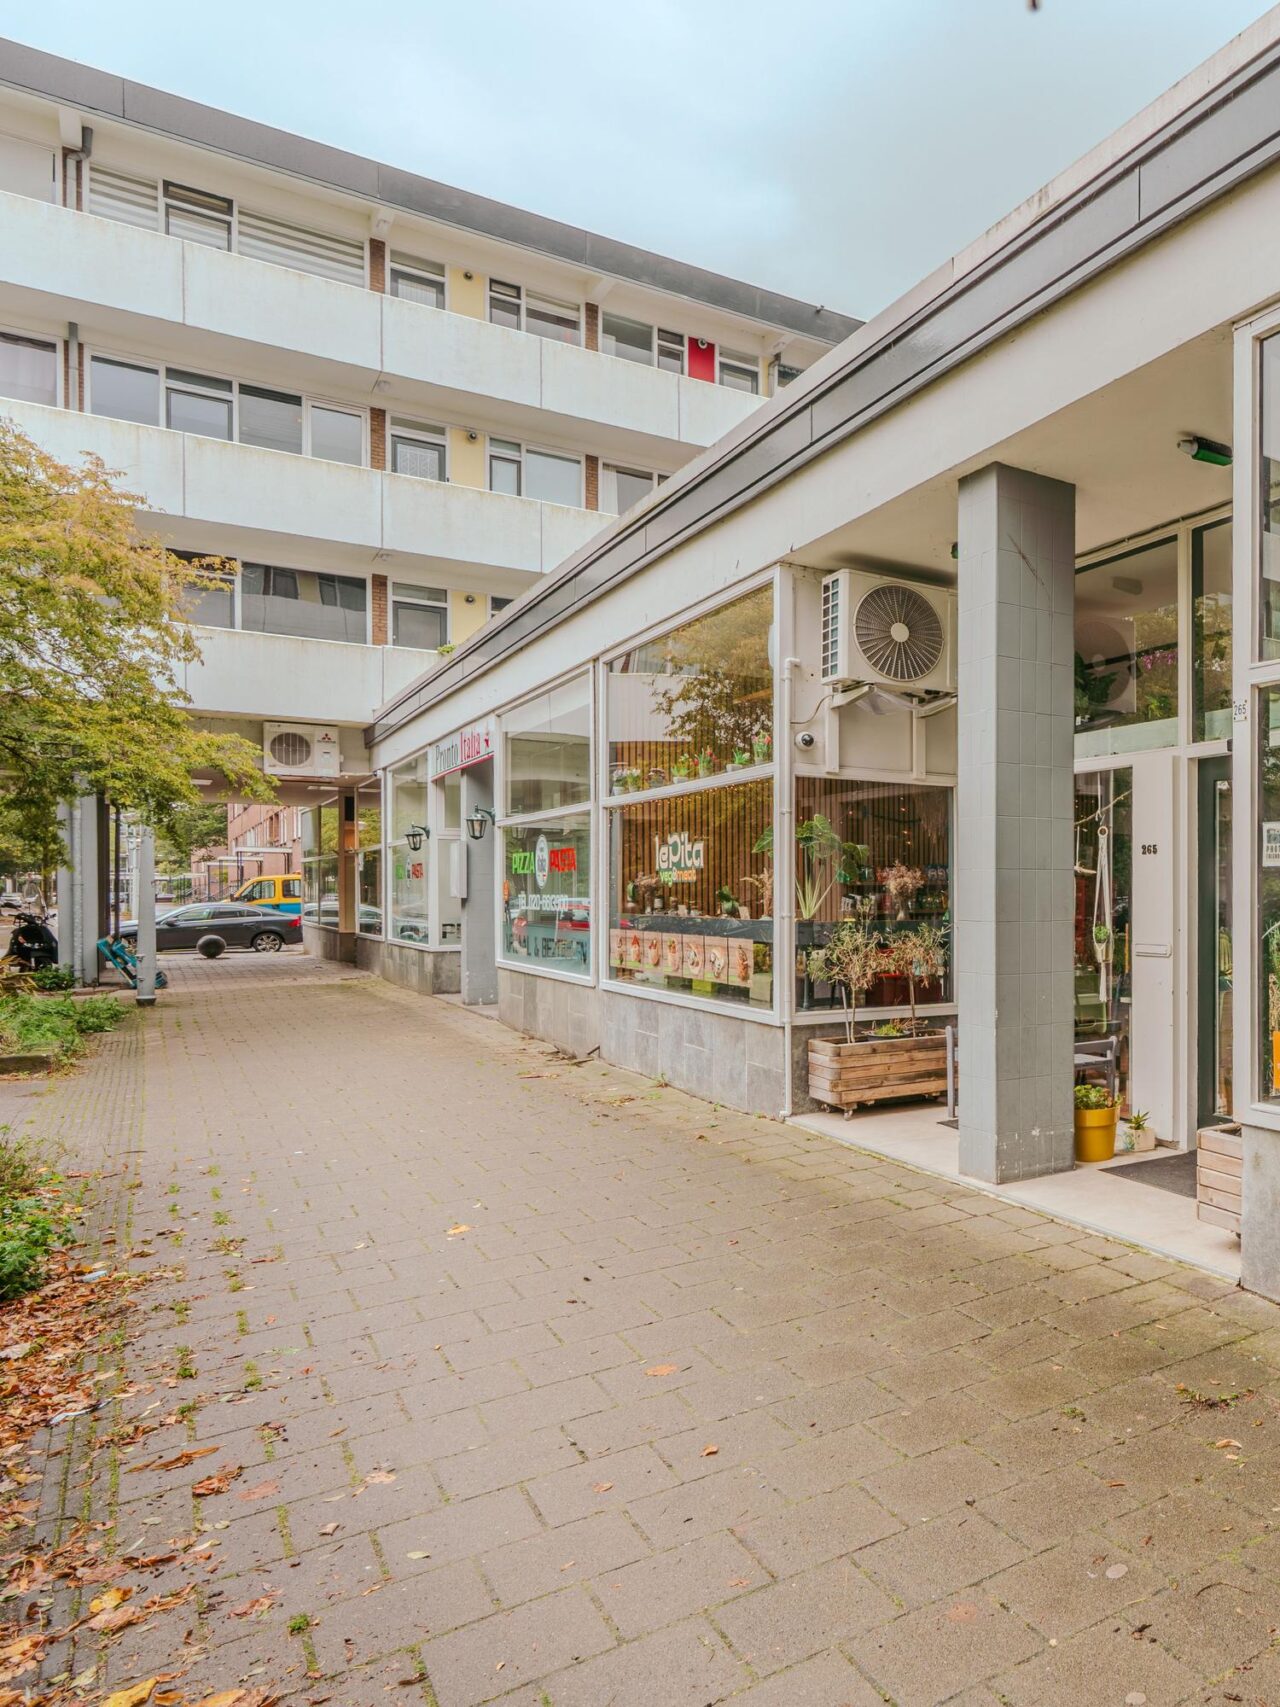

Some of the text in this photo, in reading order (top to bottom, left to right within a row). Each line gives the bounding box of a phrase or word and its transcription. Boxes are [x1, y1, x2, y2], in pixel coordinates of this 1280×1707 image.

[1234, 703, 1247, 716] 265
[435, 731, 481, 773] Pronto Italia
[1141, 844, 1158, 856] 265
[512, 850, 535, 874] PIZZA
[549, 847, 577, 873] PASTA
